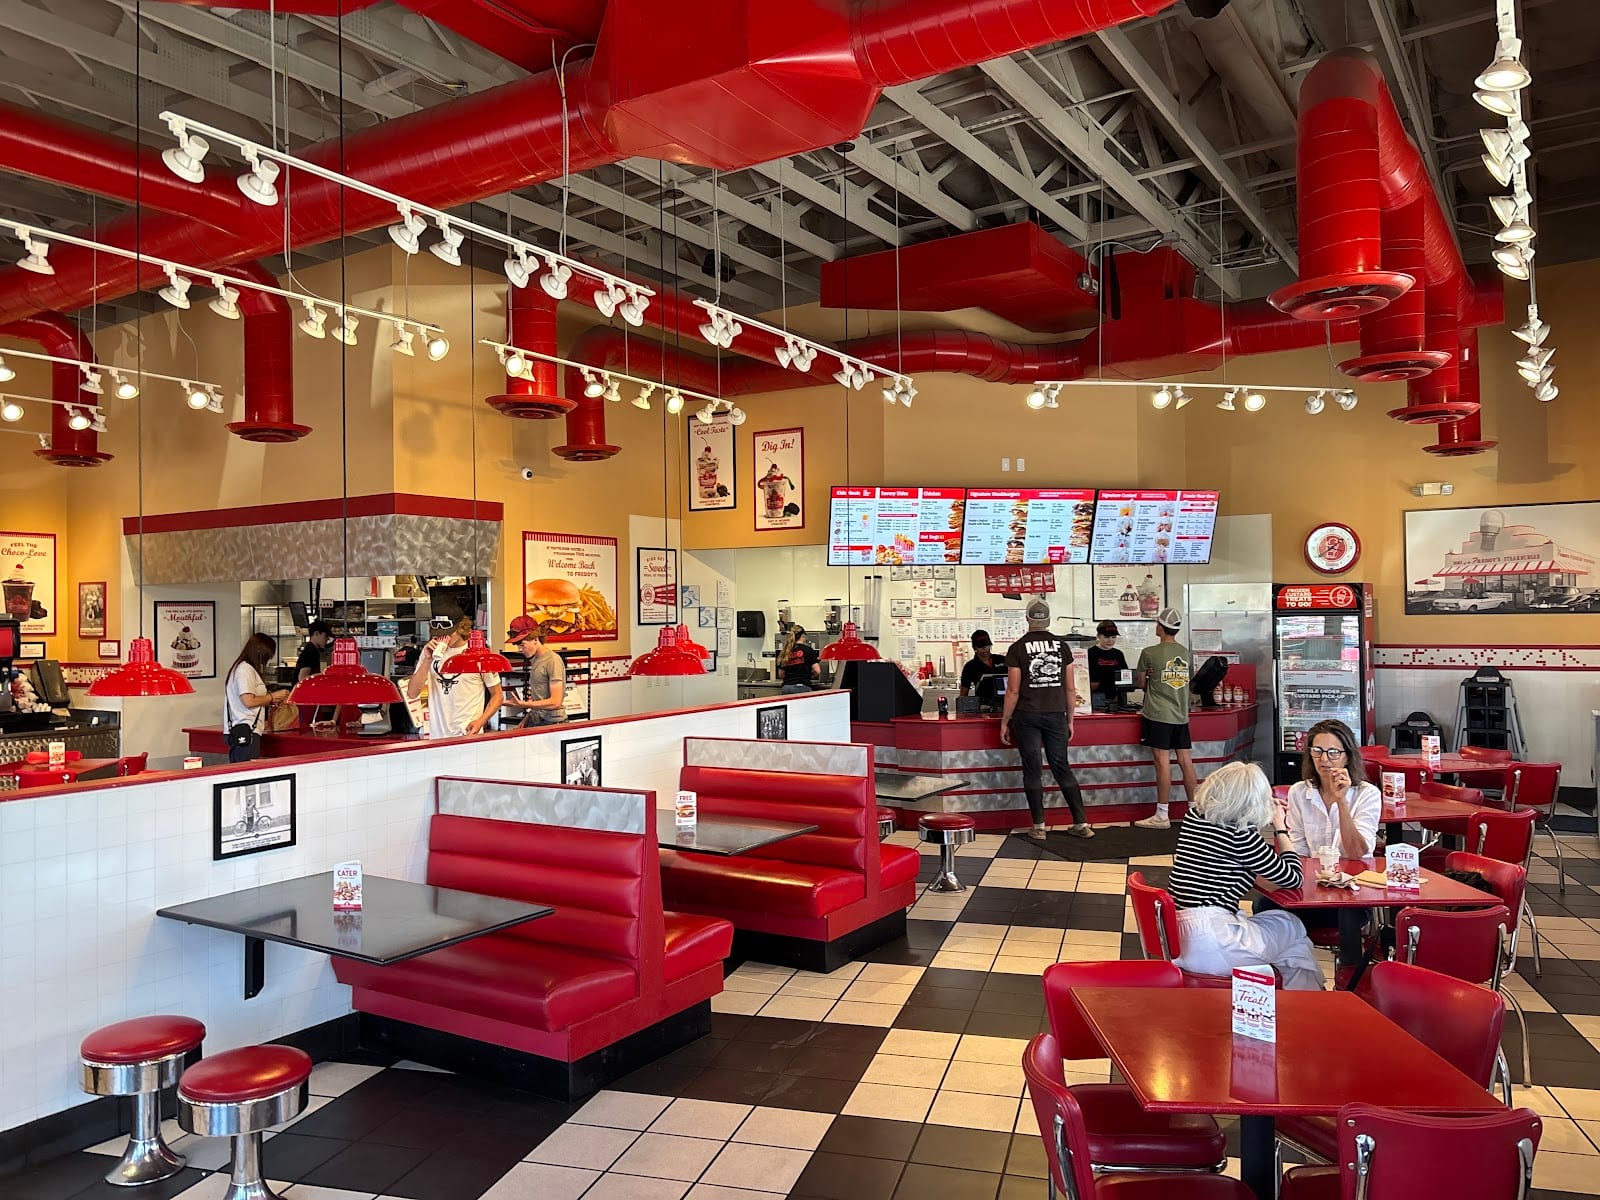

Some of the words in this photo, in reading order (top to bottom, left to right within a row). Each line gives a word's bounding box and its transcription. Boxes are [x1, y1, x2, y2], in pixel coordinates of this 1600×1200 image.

[762, 441, 778, 453] Dig
[780, 439, 795, 449] In!
[1, 547, 47, 557] Choco-Love
[548, 558, 577, 568] Welcome
[578, 560, 596, 569] Back
[170, 613, 203, 623] Mouthful
[1025, 640, 1061, 654] MILF
[1390, 851, 1415, 860] CATER
[1238, 989, 1268, 1006] Treat!
